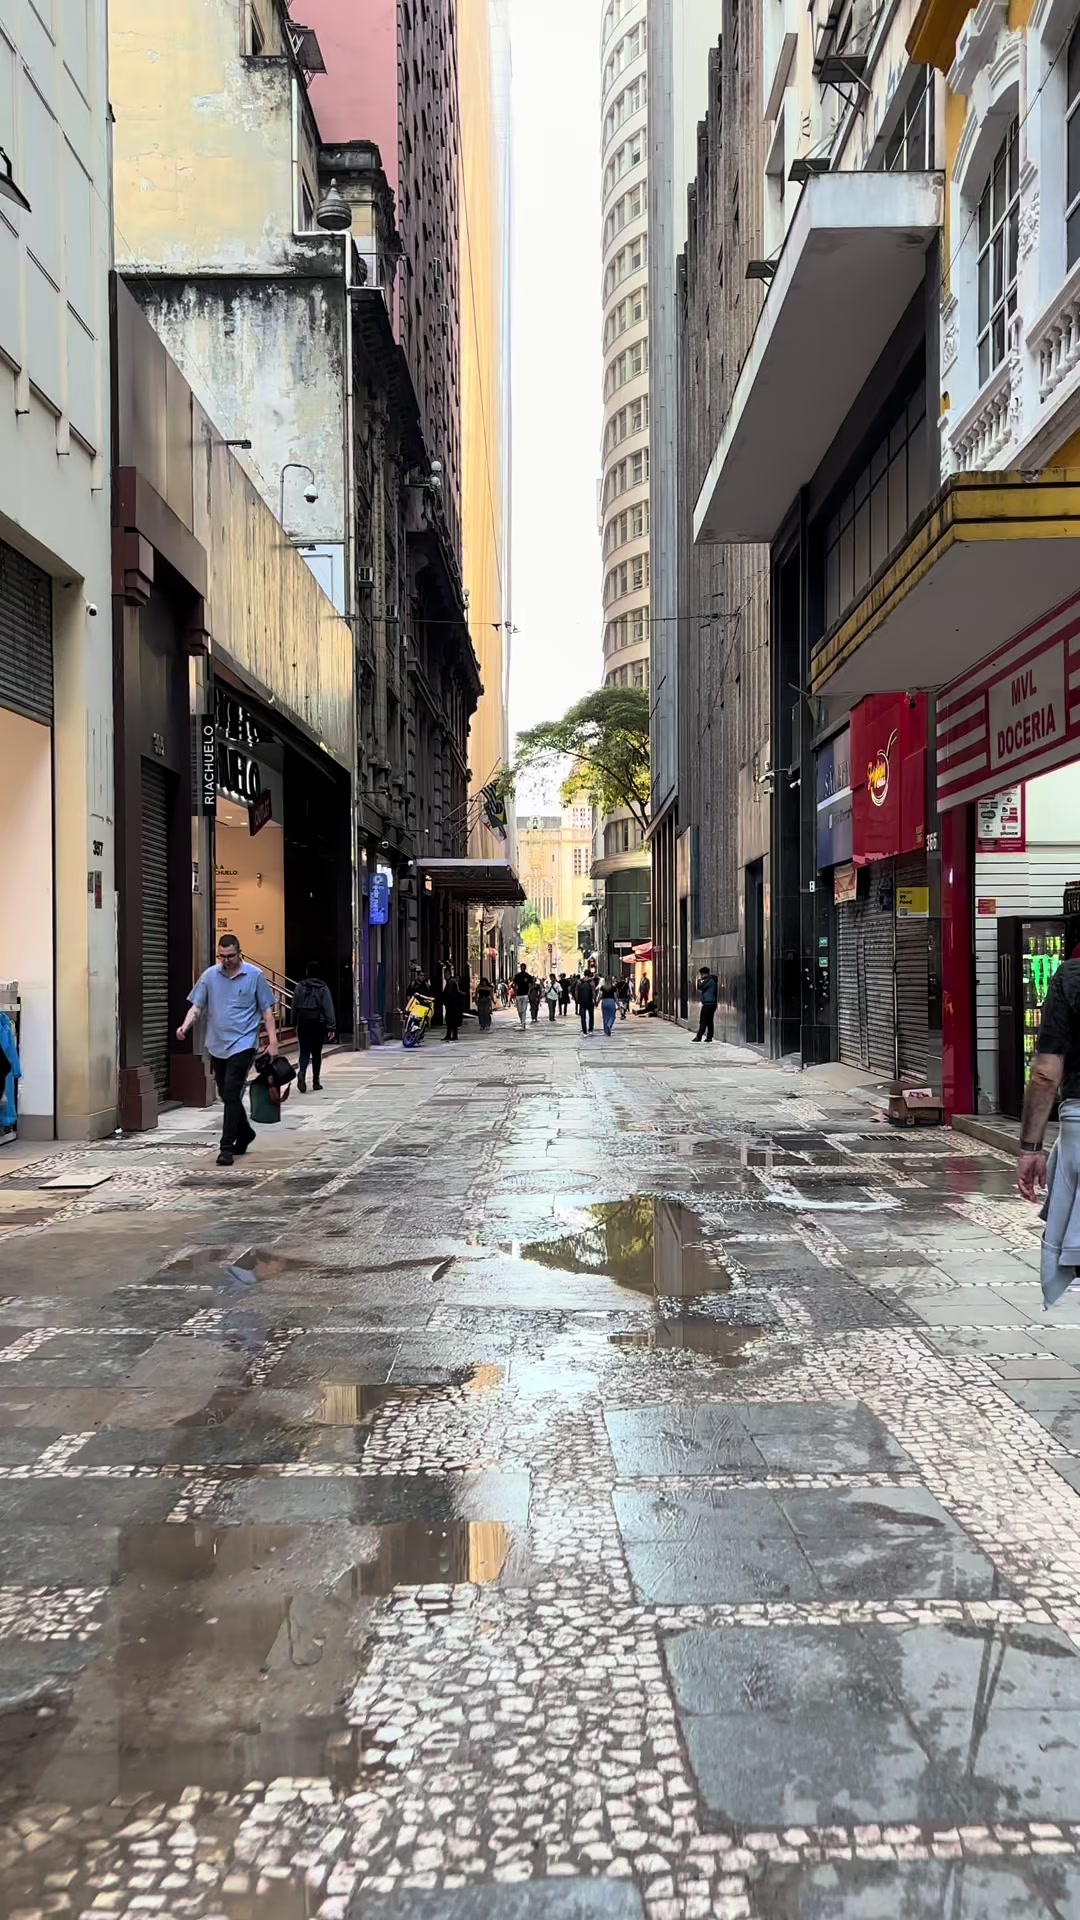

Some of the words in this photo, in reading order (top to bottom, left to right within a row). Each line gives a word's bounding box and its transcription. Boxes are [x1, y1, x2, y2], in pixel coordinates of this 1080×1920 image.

[1011, 669, 1037, 707] MVL
[997, 703, 1056, 760] DOCERIA
[203, 725, 215, 805] RIACHUELO
[92, 839, 104, 856] 357
